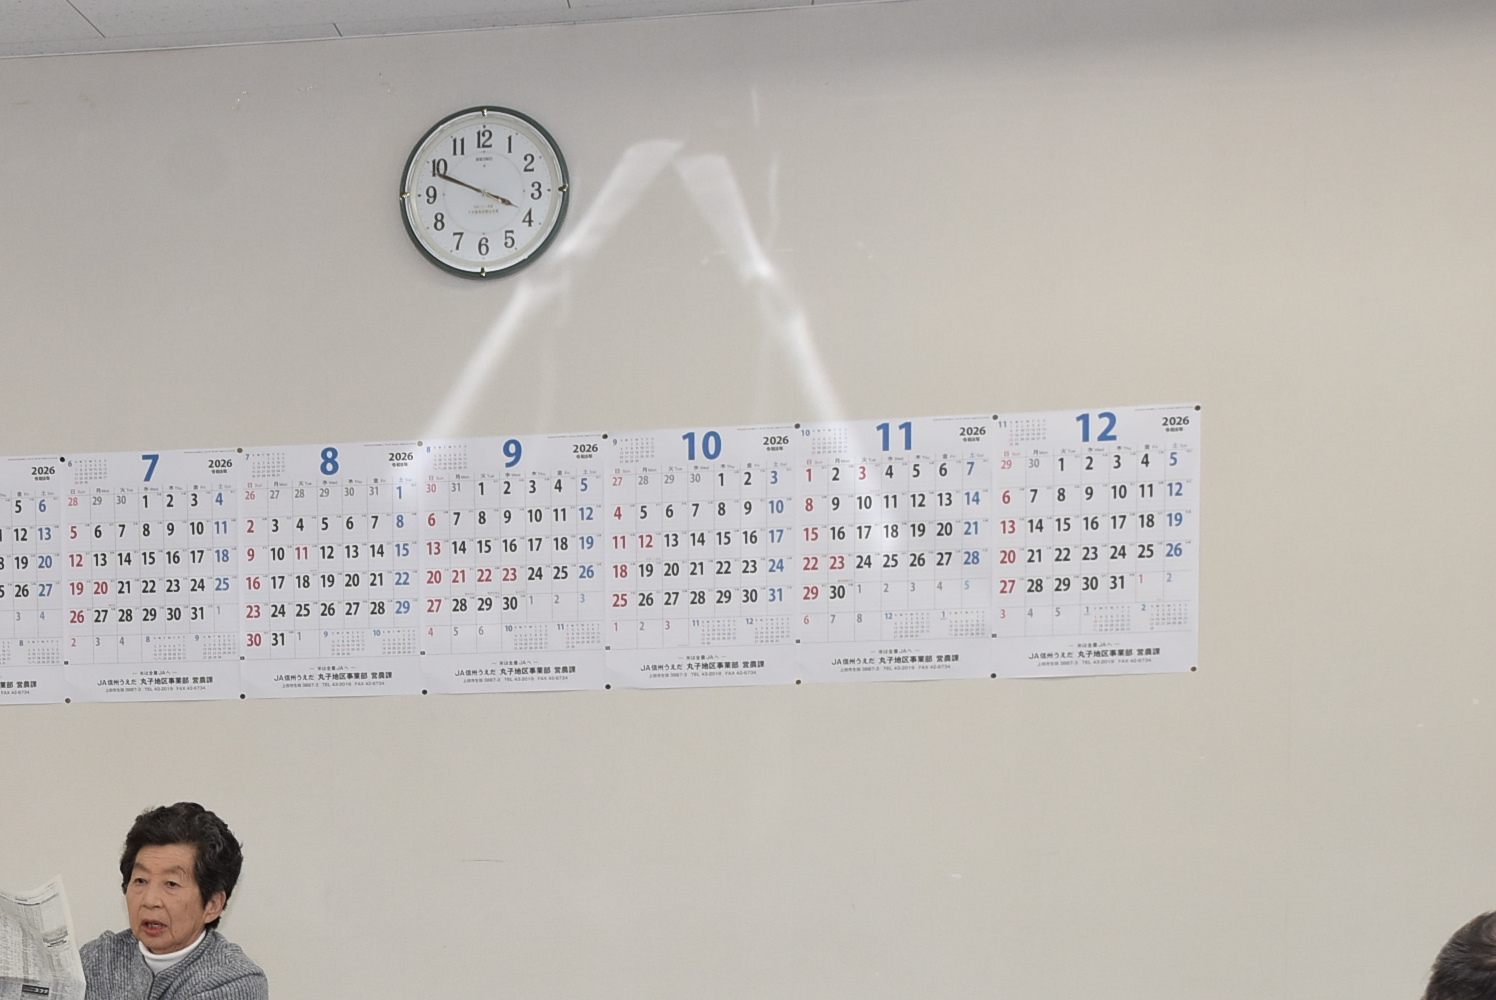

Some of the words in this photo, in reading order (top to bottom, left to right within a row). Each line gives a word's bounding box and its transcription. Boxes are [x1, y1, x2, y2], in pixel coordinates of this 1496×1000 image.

[452, 137, 465, 156] 11
[476, 129, 493, 149] 12
[507, 135, 512, 153] 1
[431, 158, 448, 177] 10
[523, 153, 535, 172] 2
[425, 186, 437, 204] 9
[530, 181, 542, 200] 3
[433, 212, 445, 231] 8
[522, 207, 534, 227] 4
[453, 232, 464, 250] 7
[478, 237, 489, 256] 6
[504, 230, 515, 248] 5
[1076, 412, 1117, 442] 12
[1162, 416, 1189, 426] 2026
[763, 435, 789, 445] 2026
[876, 422, 912, 451] 11
[959, 426, 986, 436] 2026
[503, 439, 522, 468] 9
[573, 444, 598, 453] 2026
[682, 431, 722, 460] 10
[208, 459, 233, 468] 2026
[320, 447, 339, 475] 8
[389, 452, 413, 461] 2026
[31, 466, 55, 475] 2026
[142, 454, 159, 482] 7
[1002, 490, 1011, 504] 6
[1030, 489, 1038, 503] 7
[1057, 488, 1066, 502] 8
[1085, 486, 1093, 500] 9
[1111, 485, 1127, 499] 10
[1139, 483, 1153, 498] 11
[1167, 482, 1182, 496] 12
[69, 554, 83, 567] 12
[93, 553, 107, 567] 13
[117, 552, 132, 566] 14
[142, 551, 155, 565] 15
[166, 551, 180, 564] 16
[190, 550, 204, 563] 17
[215, 549, 229, 562] 18
[613, 564, 628, 578] 18
[639, 563, 653, 577] 19
[664, 562, 679, 576] 20
[690, 562, 703, 575] 21
[716, 560, 731, 574] 22
[742, 560, 757, 574] 23
[768, 559, 784, 572] 24
